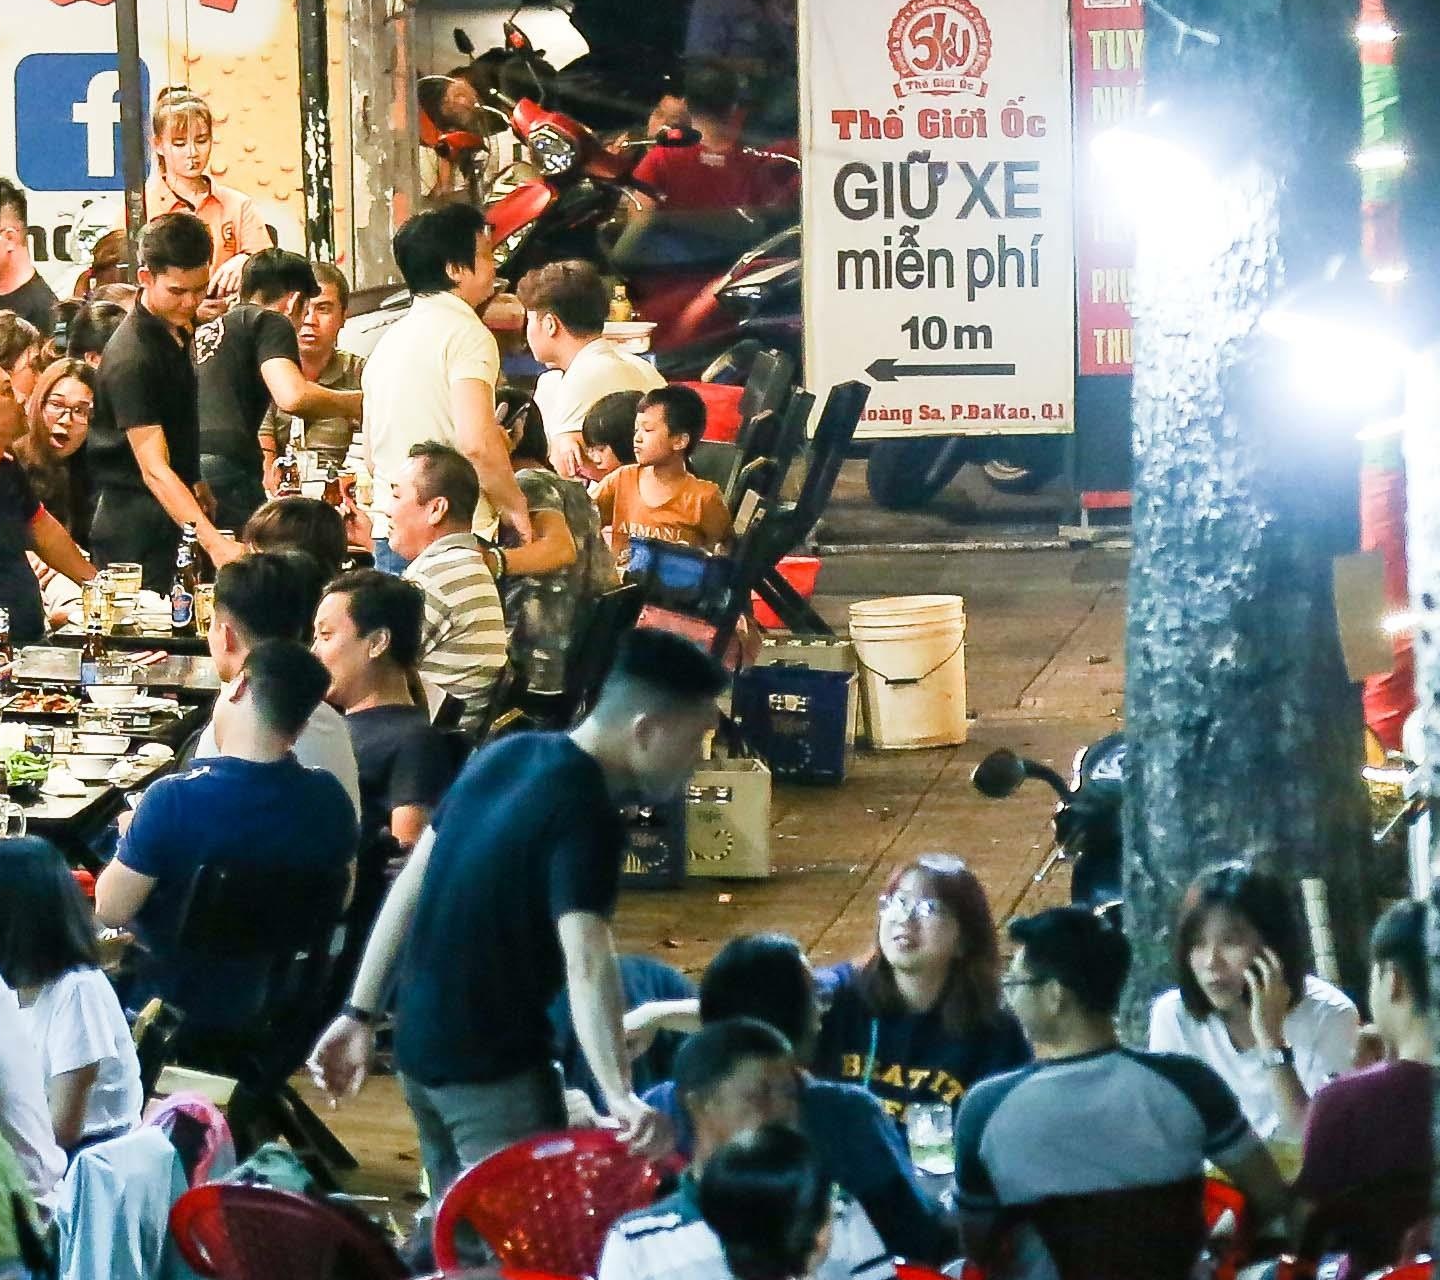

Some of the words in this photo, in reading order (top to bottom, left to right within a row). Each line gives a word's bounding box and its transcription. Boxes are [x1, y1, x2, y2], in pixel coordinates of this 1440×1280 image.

[831, 104, 906, 140] Thế
[917, 107, 989, 139] Giới
[1001, 96, 1047, 139] Ốc
[834, 149, 949, 221] GIỮ
[955, 160, 1043, 220] XE
[837, 225, 954, 290] miễn
[967, 233, 1044, 302] phí
[859, 403, 913, 425] oàng
